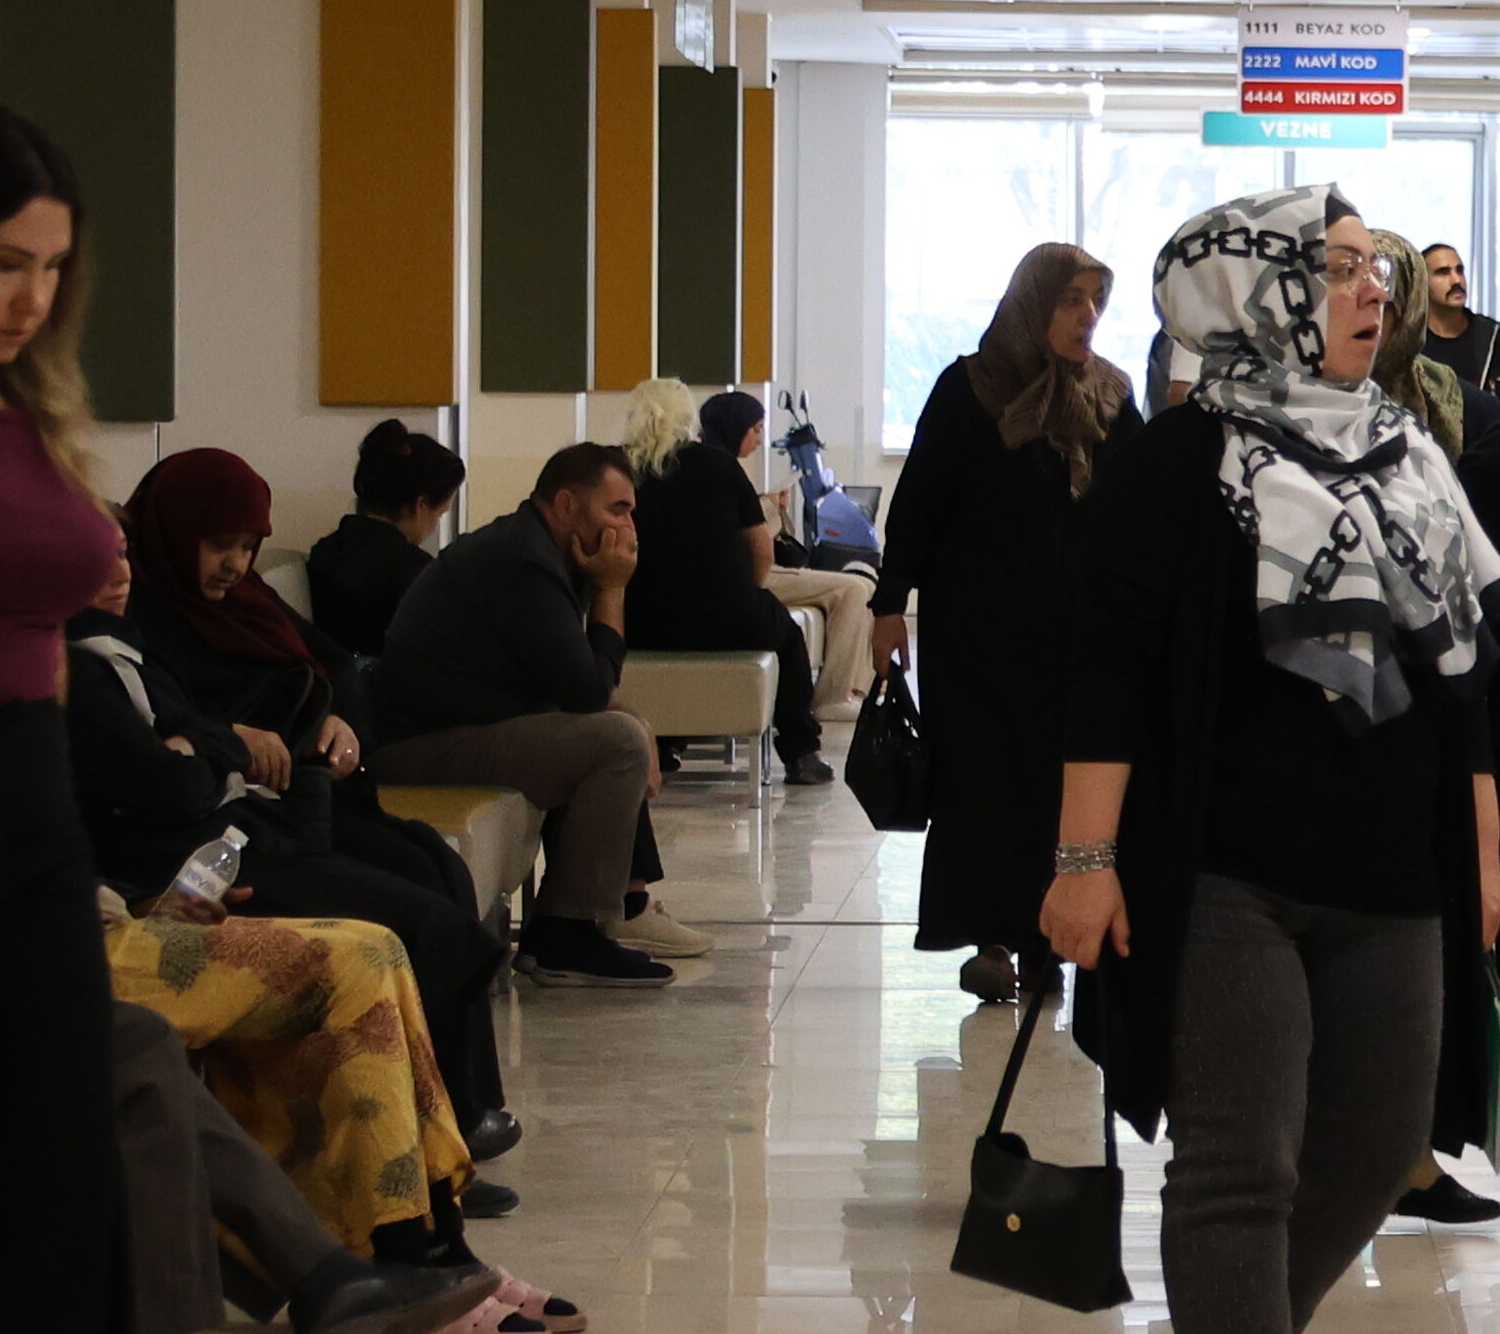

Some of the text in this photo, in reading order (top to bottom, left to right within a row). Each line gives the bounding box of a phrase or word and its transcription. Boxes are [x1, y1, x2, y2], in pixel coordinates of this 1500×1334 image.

[1245, 21, 1386, 36] 1111 BEYAZ KOD
[1244, 53, 1378, 70] 2222 MAVİ KOD
[1244, 91, 1397, 107] 4444 KIRMIZI KOD
[1260, 120, 1332, 140] VEZNE
